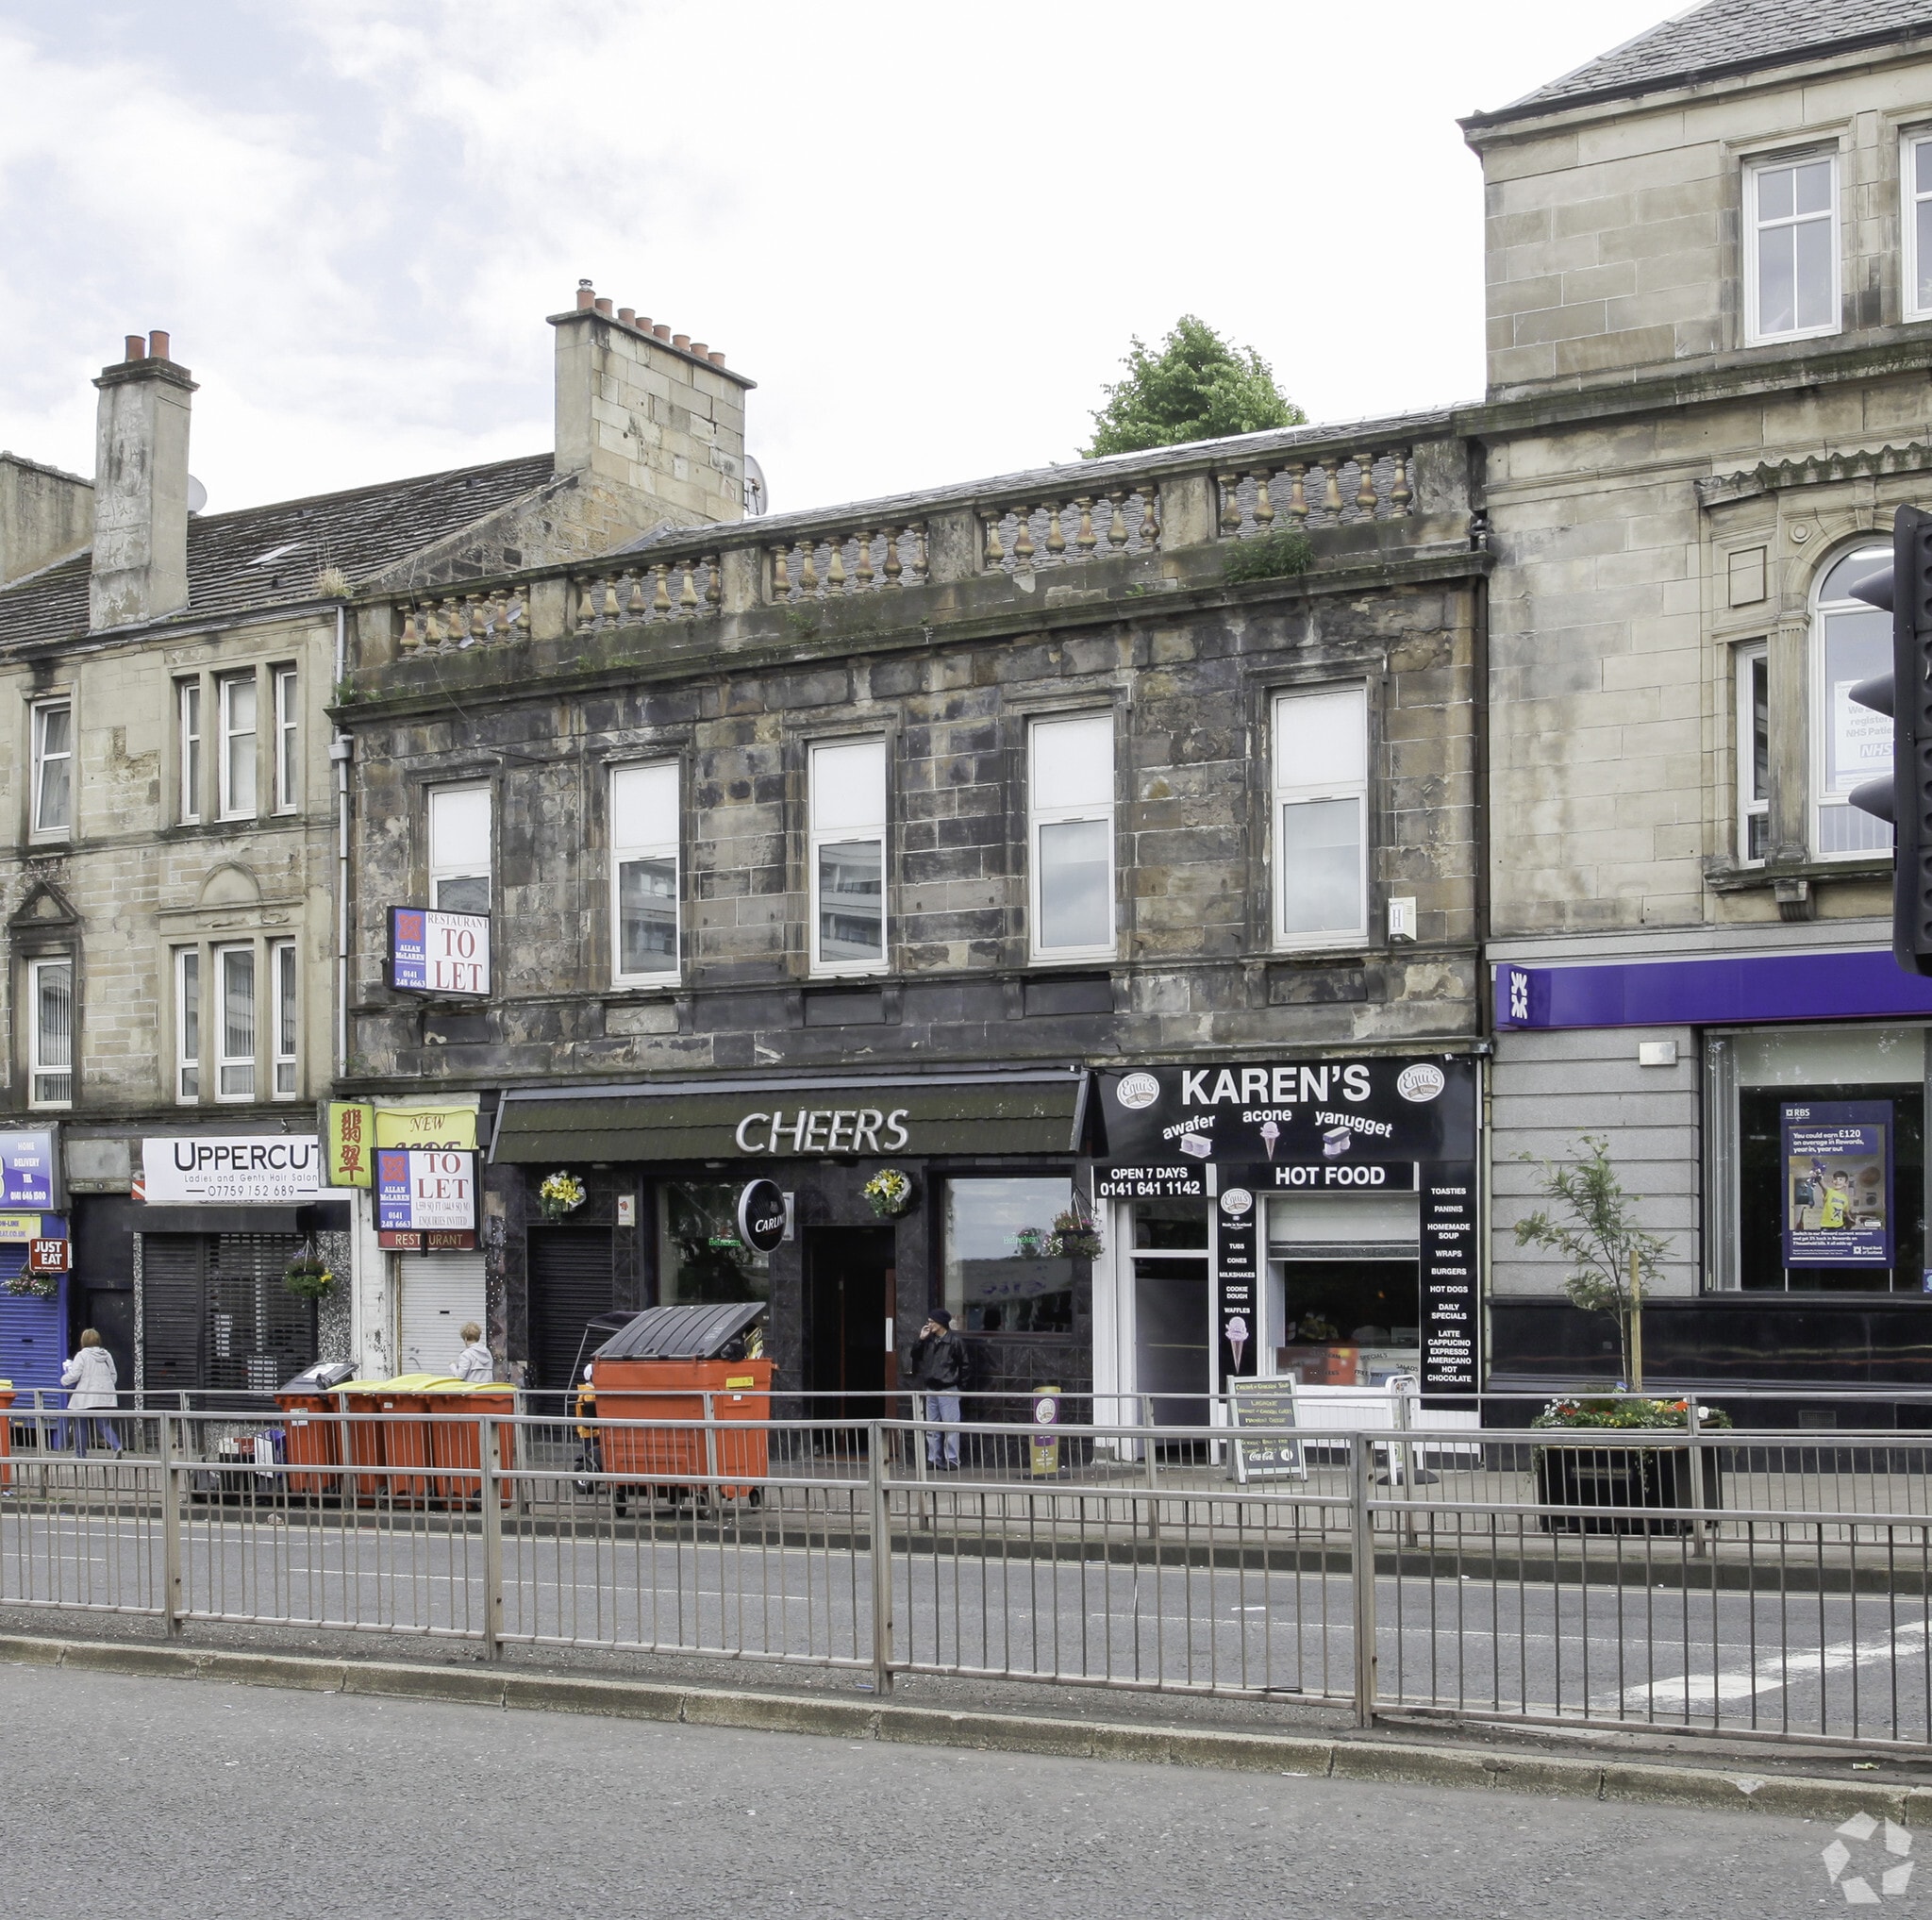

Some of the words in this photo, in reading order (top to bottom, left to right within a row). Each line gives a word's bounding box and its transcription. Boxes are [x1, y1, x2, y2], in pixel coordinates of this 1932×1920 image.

[1848, 706, 1864, 714] We
[1845, 728, 1866, 738] NHS
[1861, 743, 1892, 757] NHS
[427, 912, 489, 929] RESTAURANT
[400, 943, 421, 953] ALLAN
[441, 927, 475, 959] TO
[403, 970, 417, 979] 0141
[434, 960, 483, 992] LET
[396, 977, 408, 987] 248
[409, 978, 425, 987] 6663
[1181, 1064, 1371, 1105] KAREN'S
[1241, 1109, 1292, 1123] acone
[1794, 1108, 1810, 1117] RBS
[409, 1115, 445, 1132] NEW
[1162, 1114, 1216, 1140] awafer
[1315, 1111, 1392, 1138] yanugget
[735, 1109, 909, 1155] CHEERS
[1839, 1129, 1861, 1138] £120
[17, 1142, 35, 1151] HOME
[13, 1157, 40, 1167] DELIVERY
[424, 1153, 460, 1174] TO
[23, 1174, 32, 1183] TEL
[184, 1174, 212, 1183] Ladies
[218, 1174, 235, 1182] and
[240, 1174, 265, 1182] Gents
[270, 1173, 287, 1181] Hair
[292, 1173, 317, 1181] Salon
[1110, 1168, 1143, 1179] OPEN
[1146, 1168, 1154, 1179] 7
[1155, 1168, 1188, 1179] DAYS
[1275, 1166, 1321, 1185] HOT
[1324, 1166, 1386, 1185] FOOD
[208, 1185, 243, 1196] 07759
[248, 1185, 269, 1196] 152
[274, 1185, 294, 1196] 689
[418, 1177, 470, 1199] LET
[1100, 1181, 1133, 1196] 0141
[1136, 1181, 1161, 1196] 641
[1167, 1181, 1200, 1194] 1142
[1430, 1187, 1466, 1195] TOASTIES
[22, 1191, 33, 1201] 646
[33, 1191, 46, 1201] 1500
[1427, 1223, 1471, 1231] HOMEMADE
[395, 1234, 463, 1245] RESTURANT
[34, 1242, 62, 1253] JUST
[1435, 1249, 1462, 1258] WRAPS
[41, 1253, 62, 1265] EAT
[1438, 1303, 1459, 1311] DAILY
[1438, 1329, 1460, 1338] LATTE
[1396, 1363, 1419, 1372] SALADS
[1427, 1374, 1472, 1382] CHOCOLATE
